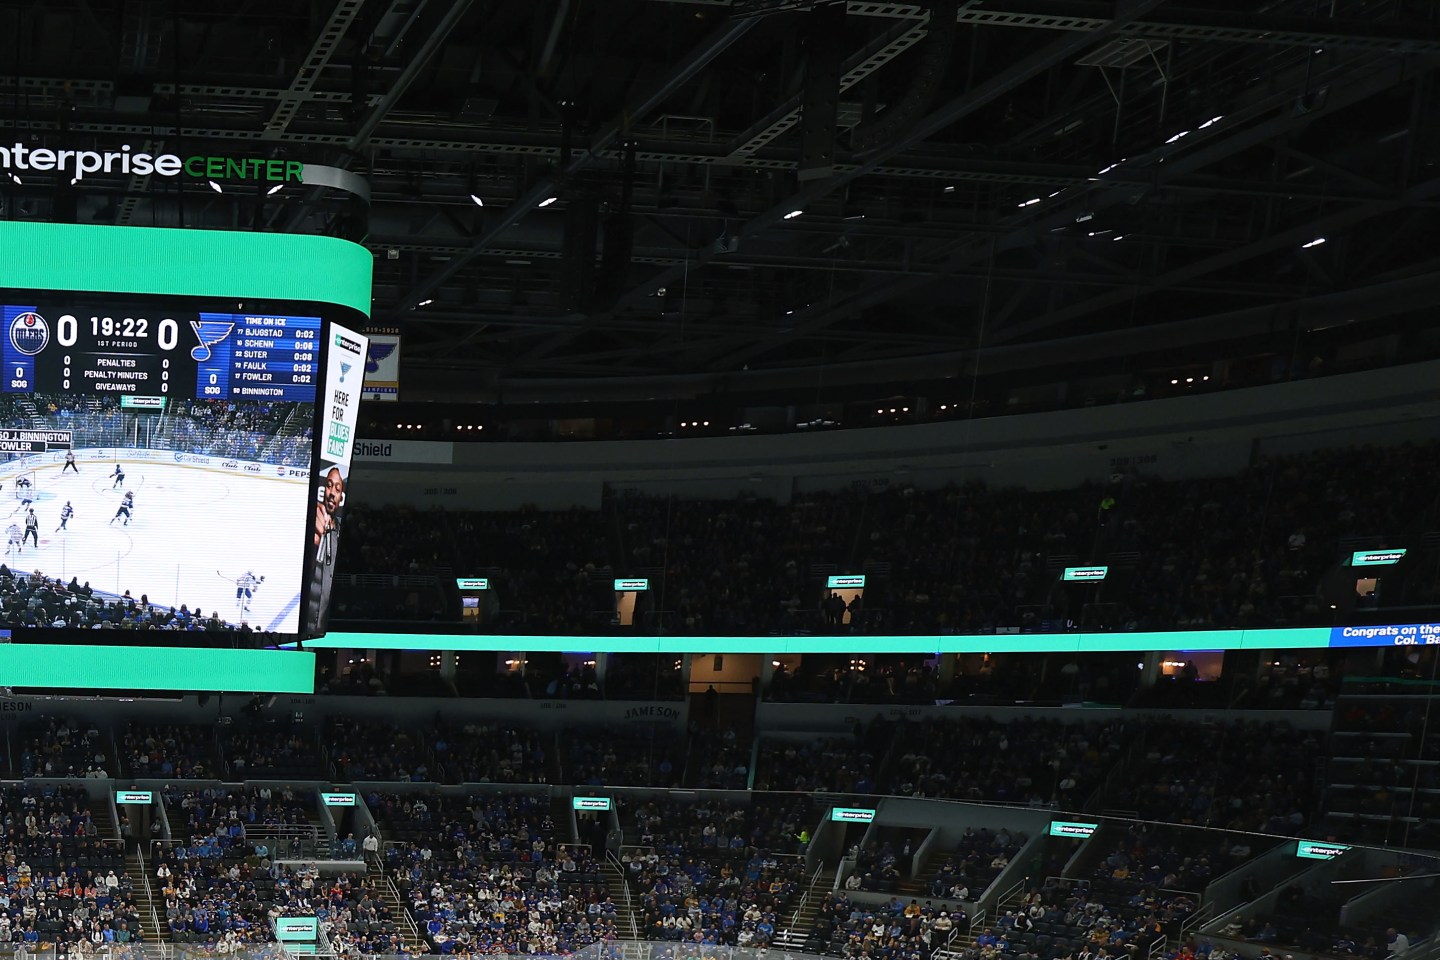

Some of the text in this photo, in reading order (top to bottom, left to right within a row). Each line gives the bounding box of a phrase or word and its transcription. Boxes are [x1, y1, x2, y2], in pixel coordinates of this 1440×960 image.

[185, 155, 303, 182] CENTER
[245, 317, 287, 326] TIME ON ICE
[57, 314, 179, 351] 0 19:22 0
[245, 328, 283, 337] BJUGSTAD
[244, 340, 274, 348] SCHENN
[243, 351, 268, 359] SUTER
[63, 355, 169, 369] 0 PENALTIES 0
[243, 362, 267, 370] FAULK
[293, 364, 311, 372] 0:02
[15, 367, 24, 378] 0
[63, 367, 169, 381] 0 PENALTY MINUTES 0
[242, 373, 311, 383] FOWLER 0:02
[11, 380, 28, 388] SOG
[209, 374, 217, 384] 0
[63, 380, 168, 393] 0 GIVEAWAYS 0
[204, 386, 221, 395] SOG
[241, 387, 284, 396] BINNINGTON
[334, 389, 350, 407] HERE
[332, 406, 344, 421] FOR
[330, 422, 350, 440] BLUES
[328, 441, 344, 456] FANS
[1343, 626, 1398, 638] Congrats
[1401, 626, 1417, 634] on
[1394, 635, 1418, 645] Col.
[624, 706, 680, 720] JAMESON
